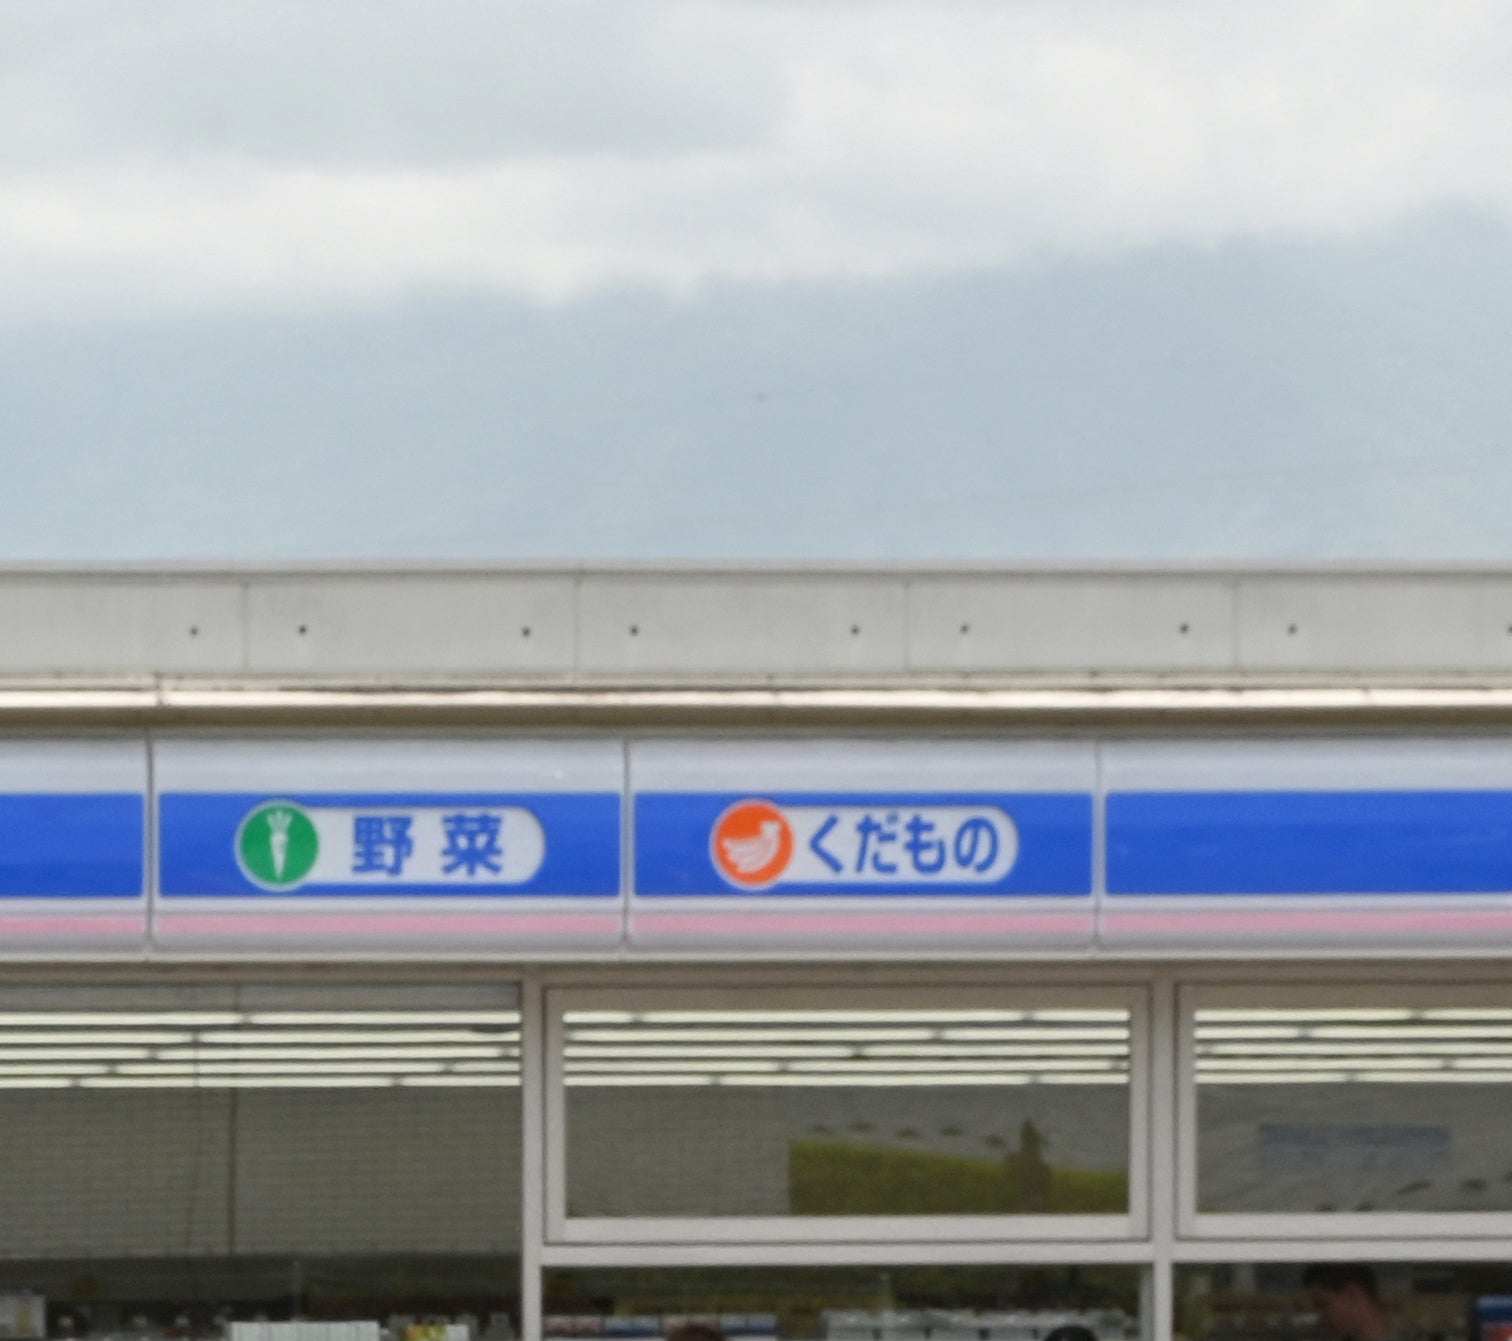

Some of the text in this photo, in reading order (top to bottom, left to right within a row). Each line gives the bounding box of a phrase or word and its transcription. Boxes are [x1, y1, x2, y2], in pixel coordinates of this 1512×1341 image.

[350, 812, 505, 880] 野菜
[806, 812, 1000, 878] くだもの
